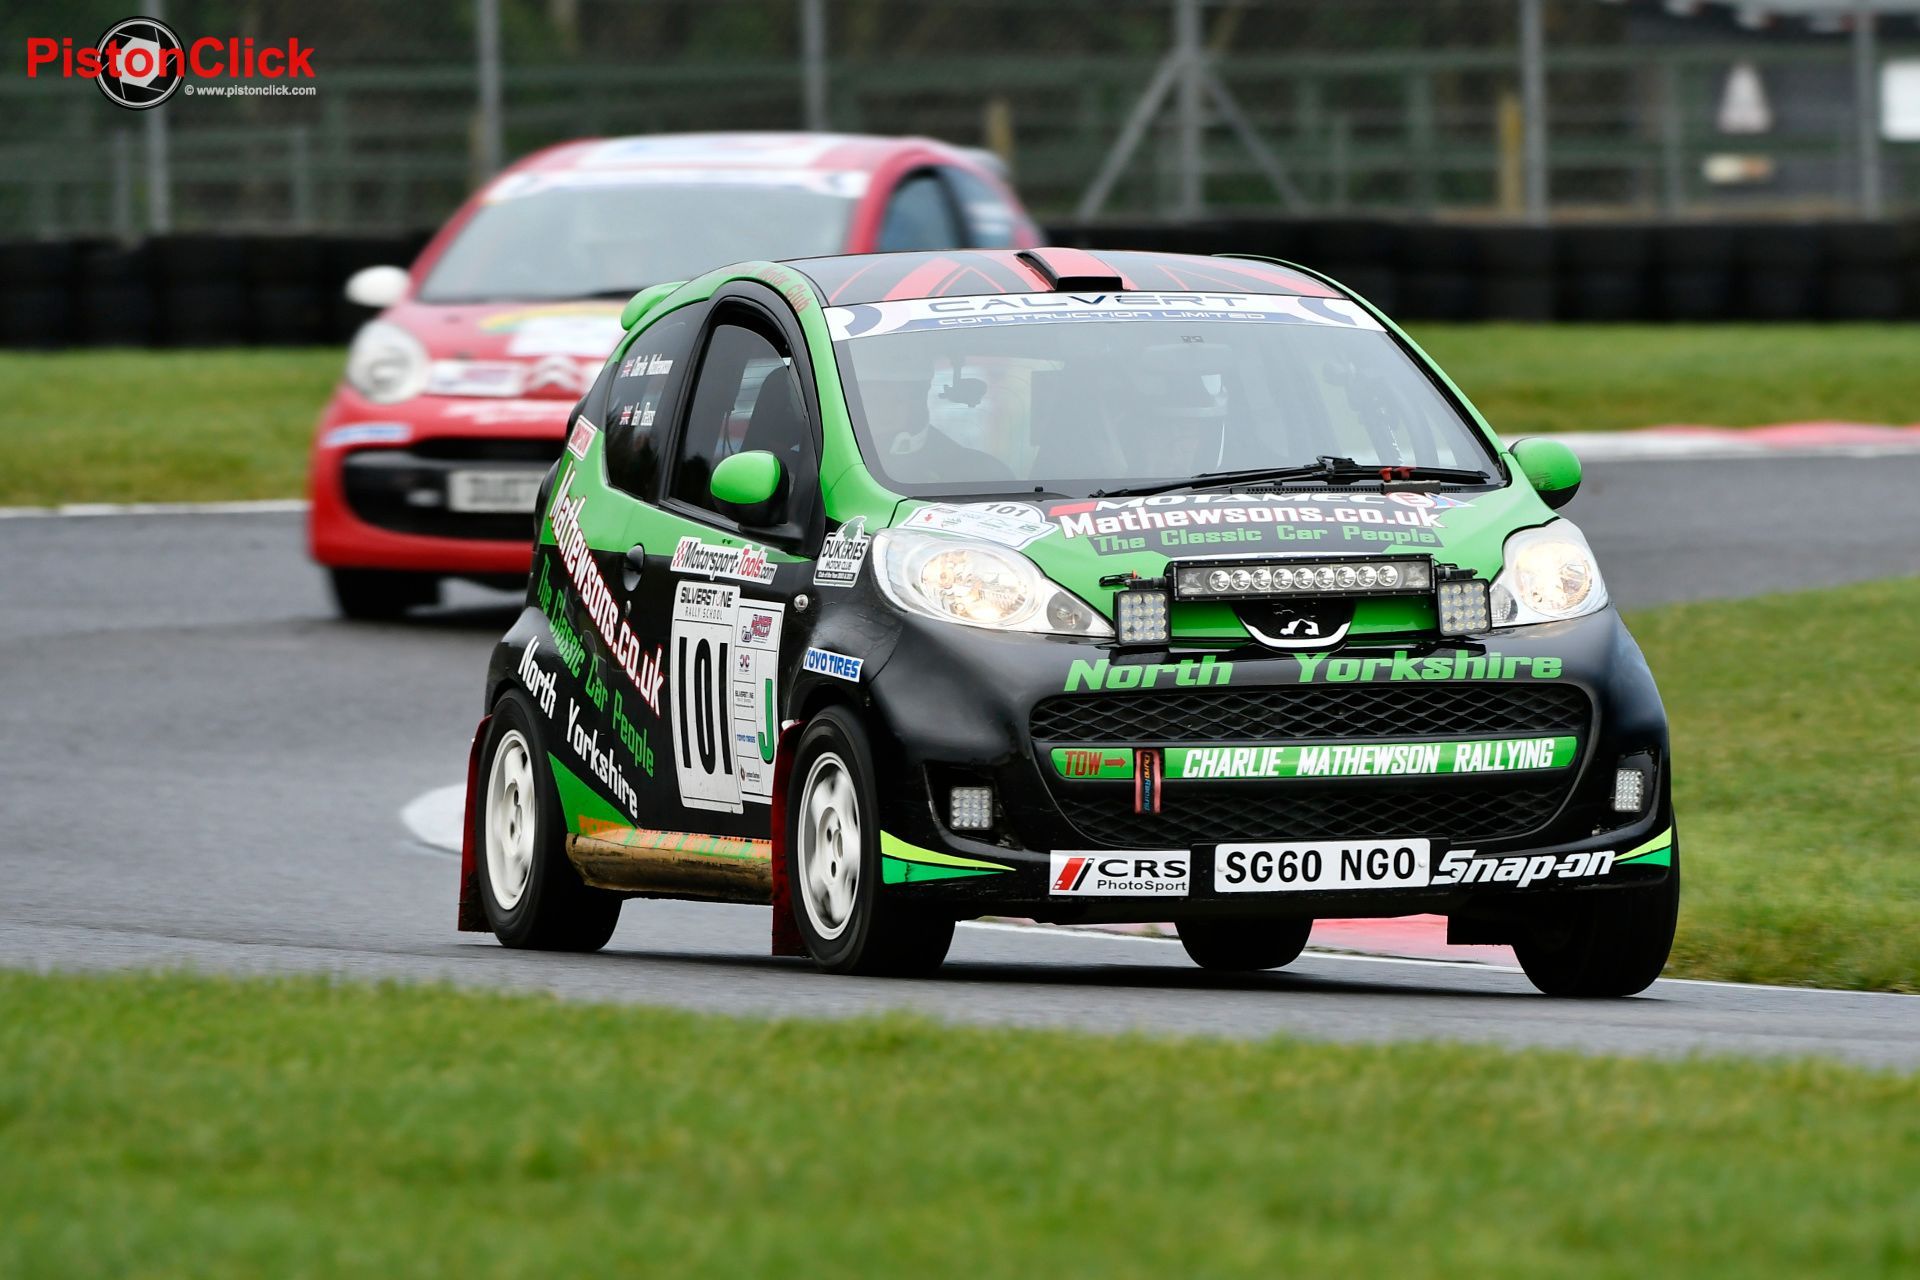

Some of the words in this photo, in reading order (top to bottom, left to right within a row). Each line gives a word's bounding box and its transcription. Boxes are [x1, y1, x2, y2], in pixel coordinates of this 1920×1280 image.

[928, 295, 1247, 312] CALVERT
[938, 311, 1152, 325] CONSTRUCTION
[1162, 311, 1265, 319] LIMITED
[985, 504, 1030, 517] 101
[1096, 493, 1385, 511] MOTAMEC
[1059, 505, 1445, 539] Mathewsons.co.uk
[822, 540, 866, 560] DUKERIES
[1093, 534, 1146, 552] The
[1160, 527, 1263, 546] Classic
[1276, 525, 1328, 541] Car
[1342, 525, 1436, 544] People
[549, 458, 664, 717] Mathewsons.co.uk
[685, 606, 702, 618] RALLY
[702, 608, 723, 620] SCHOOL
[537, 553, 552, 616] The
[550, 588, 586, 679] Classic
[585, 653, 609, 712] Car
[612, 689, 654, 777] People
[829, 655, 861, 679] TIRES
[1064, 655, 1233, 692] North
[1293, 651, 1563, 684] Yorkshire
[679, 636, 733, 775] 101
[518, 635, 557, 719] North
[566, 697, 638, 819] Yorkshire
[758, 678, 775, 765] J
[1064, 751, 1103, 777] TOW
[1183, 748, 1284, 778] CHARLIE
[1296, 745, 1440, 775] MATHEWSON
[1452, 738, 1556, 773] RALLYING
[1097, 859, 1186, 878] CRS
[1224, 850, 1322, 884] SG60
[1340, 847, 1415, 881] NGO
[1430, 849, 1615, 888] Snap-on
[1097, 879, 1186, 892] PhotoSport
